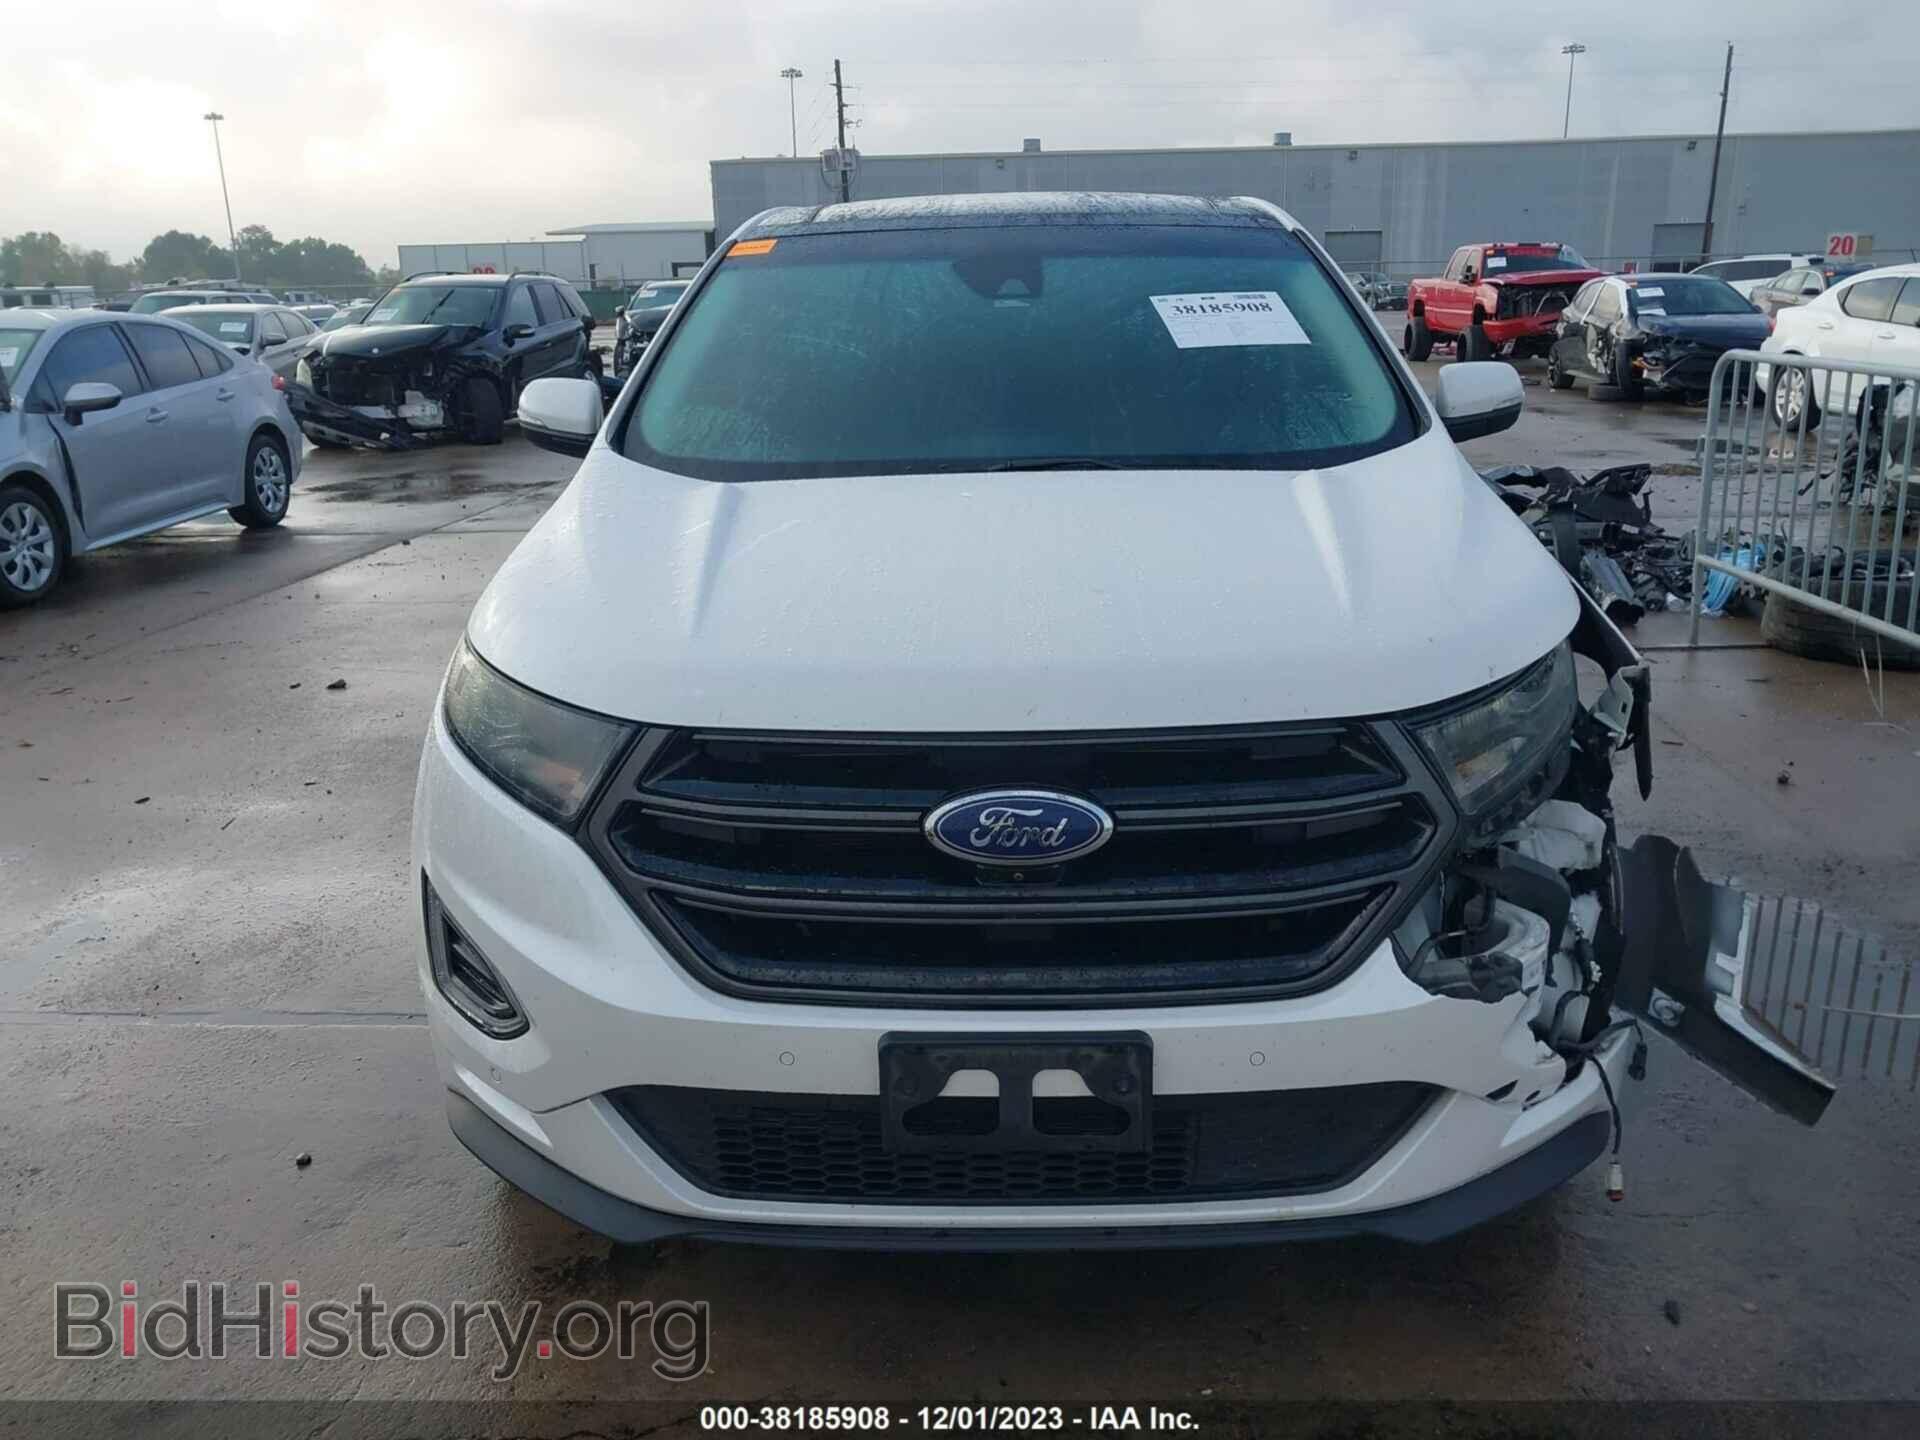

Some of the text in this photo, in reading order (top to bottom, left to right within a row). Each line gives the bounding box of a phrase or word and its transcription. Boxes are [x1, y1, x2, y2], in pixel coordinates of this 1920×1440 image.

[1829, 235, 1854, 256] 20
[1171, 302, 1273, 315] 38185908
[969, 807, 1068, 848] Ford
